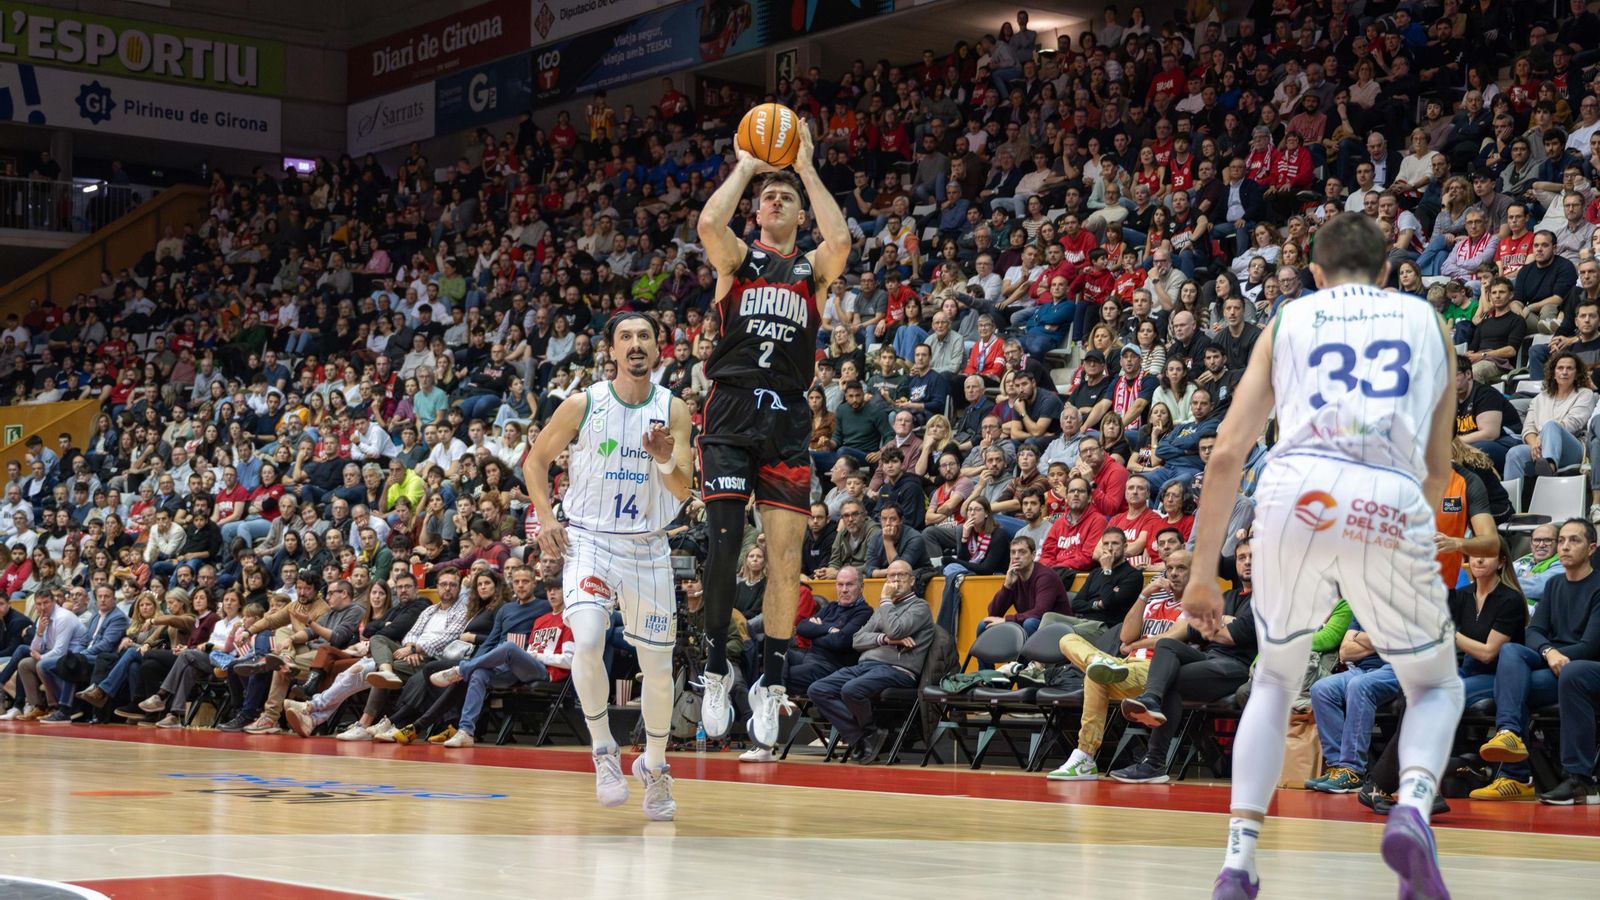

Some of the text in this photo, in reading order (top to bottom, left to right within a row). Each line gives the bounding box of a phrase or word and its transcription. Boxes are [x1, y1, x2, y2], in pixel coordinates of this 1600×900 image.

[0, 10, 258, 87] L'ESPORTIU
[372, 40, 414, 77] Diari
[417, 34, 439, 61] de
[442, 15, 503, 54] Girona
[537, 50, 561, 72] 100
[85, 93, 107, 114] G!
[124, 99, 268, 132] Pirineu de Girona
[381, 101, 424, 127] Sarrats
[774, 108, 791, 148] Wilson
[739, 286, 809, 329] GIRONA
[746, 319, 797, 343] FIATC
[758, 341, 775, 369] 2
[1308, 339, 1411, 410] 33
[620, 446, 654, 462] Unic
[614, 493, 639, 520] 14
[1351, 499, 1407, 527] COSTA
[1346, 513, 1406, 541] DEL SOL
